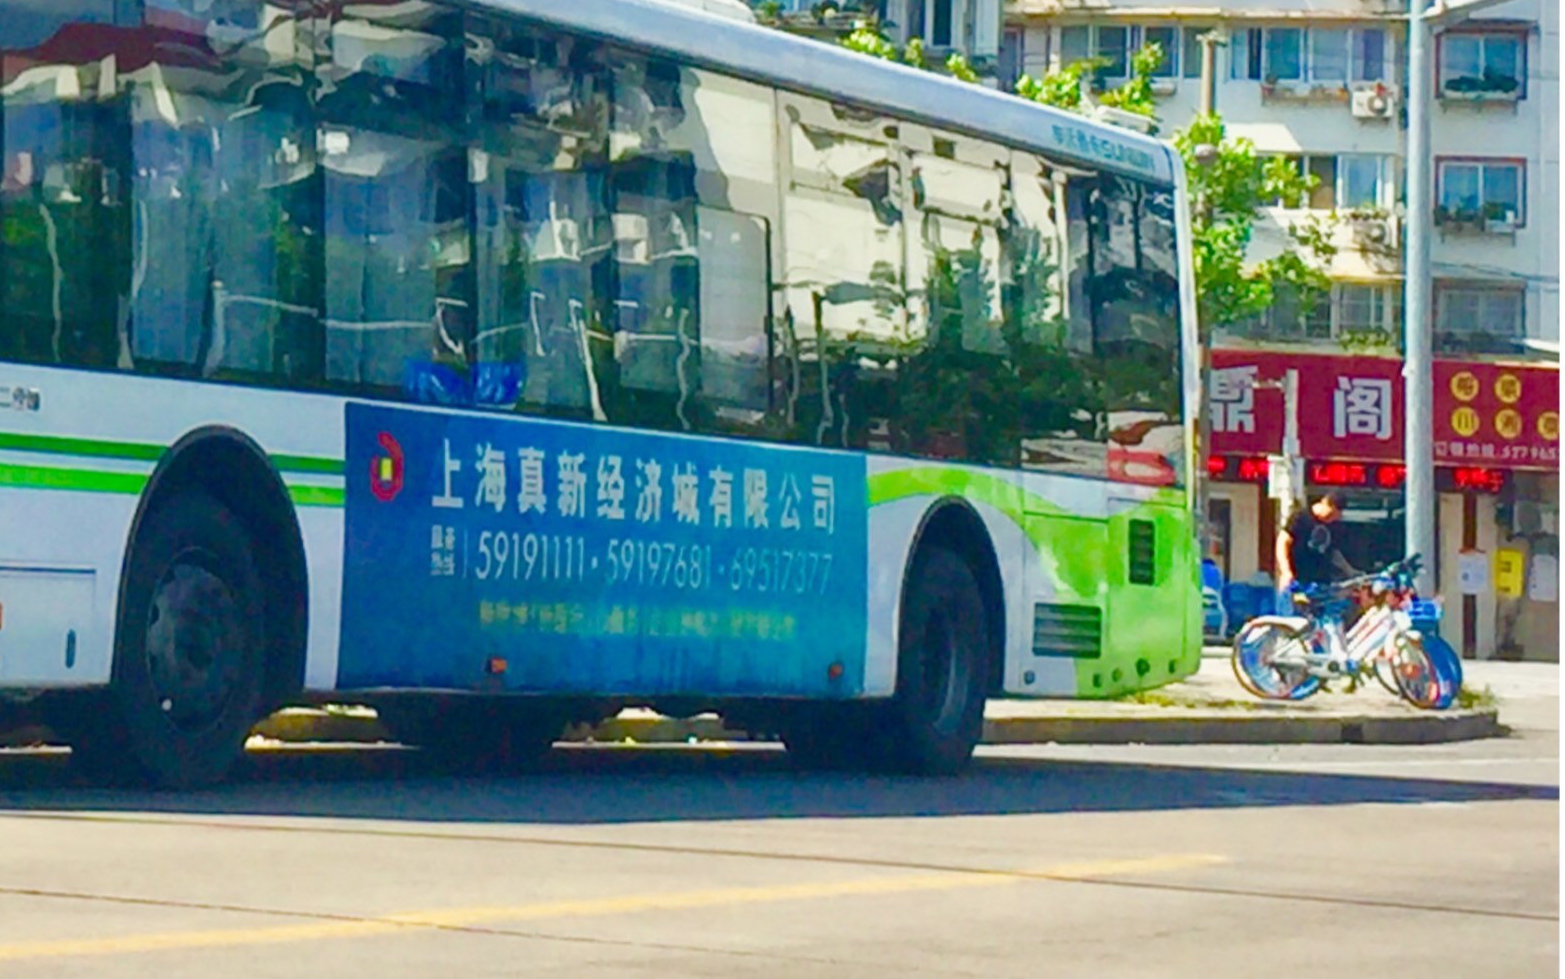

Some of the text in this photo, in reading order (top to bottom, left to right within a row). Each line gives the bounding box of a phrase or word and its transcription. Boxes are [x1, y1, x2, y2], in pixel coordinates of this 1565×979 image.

[431, 437, 835, 534] 上海真新经济城有限公司
[475, 530, 584, 580] 59191111
[606, 538, 712, 589] 59197681
